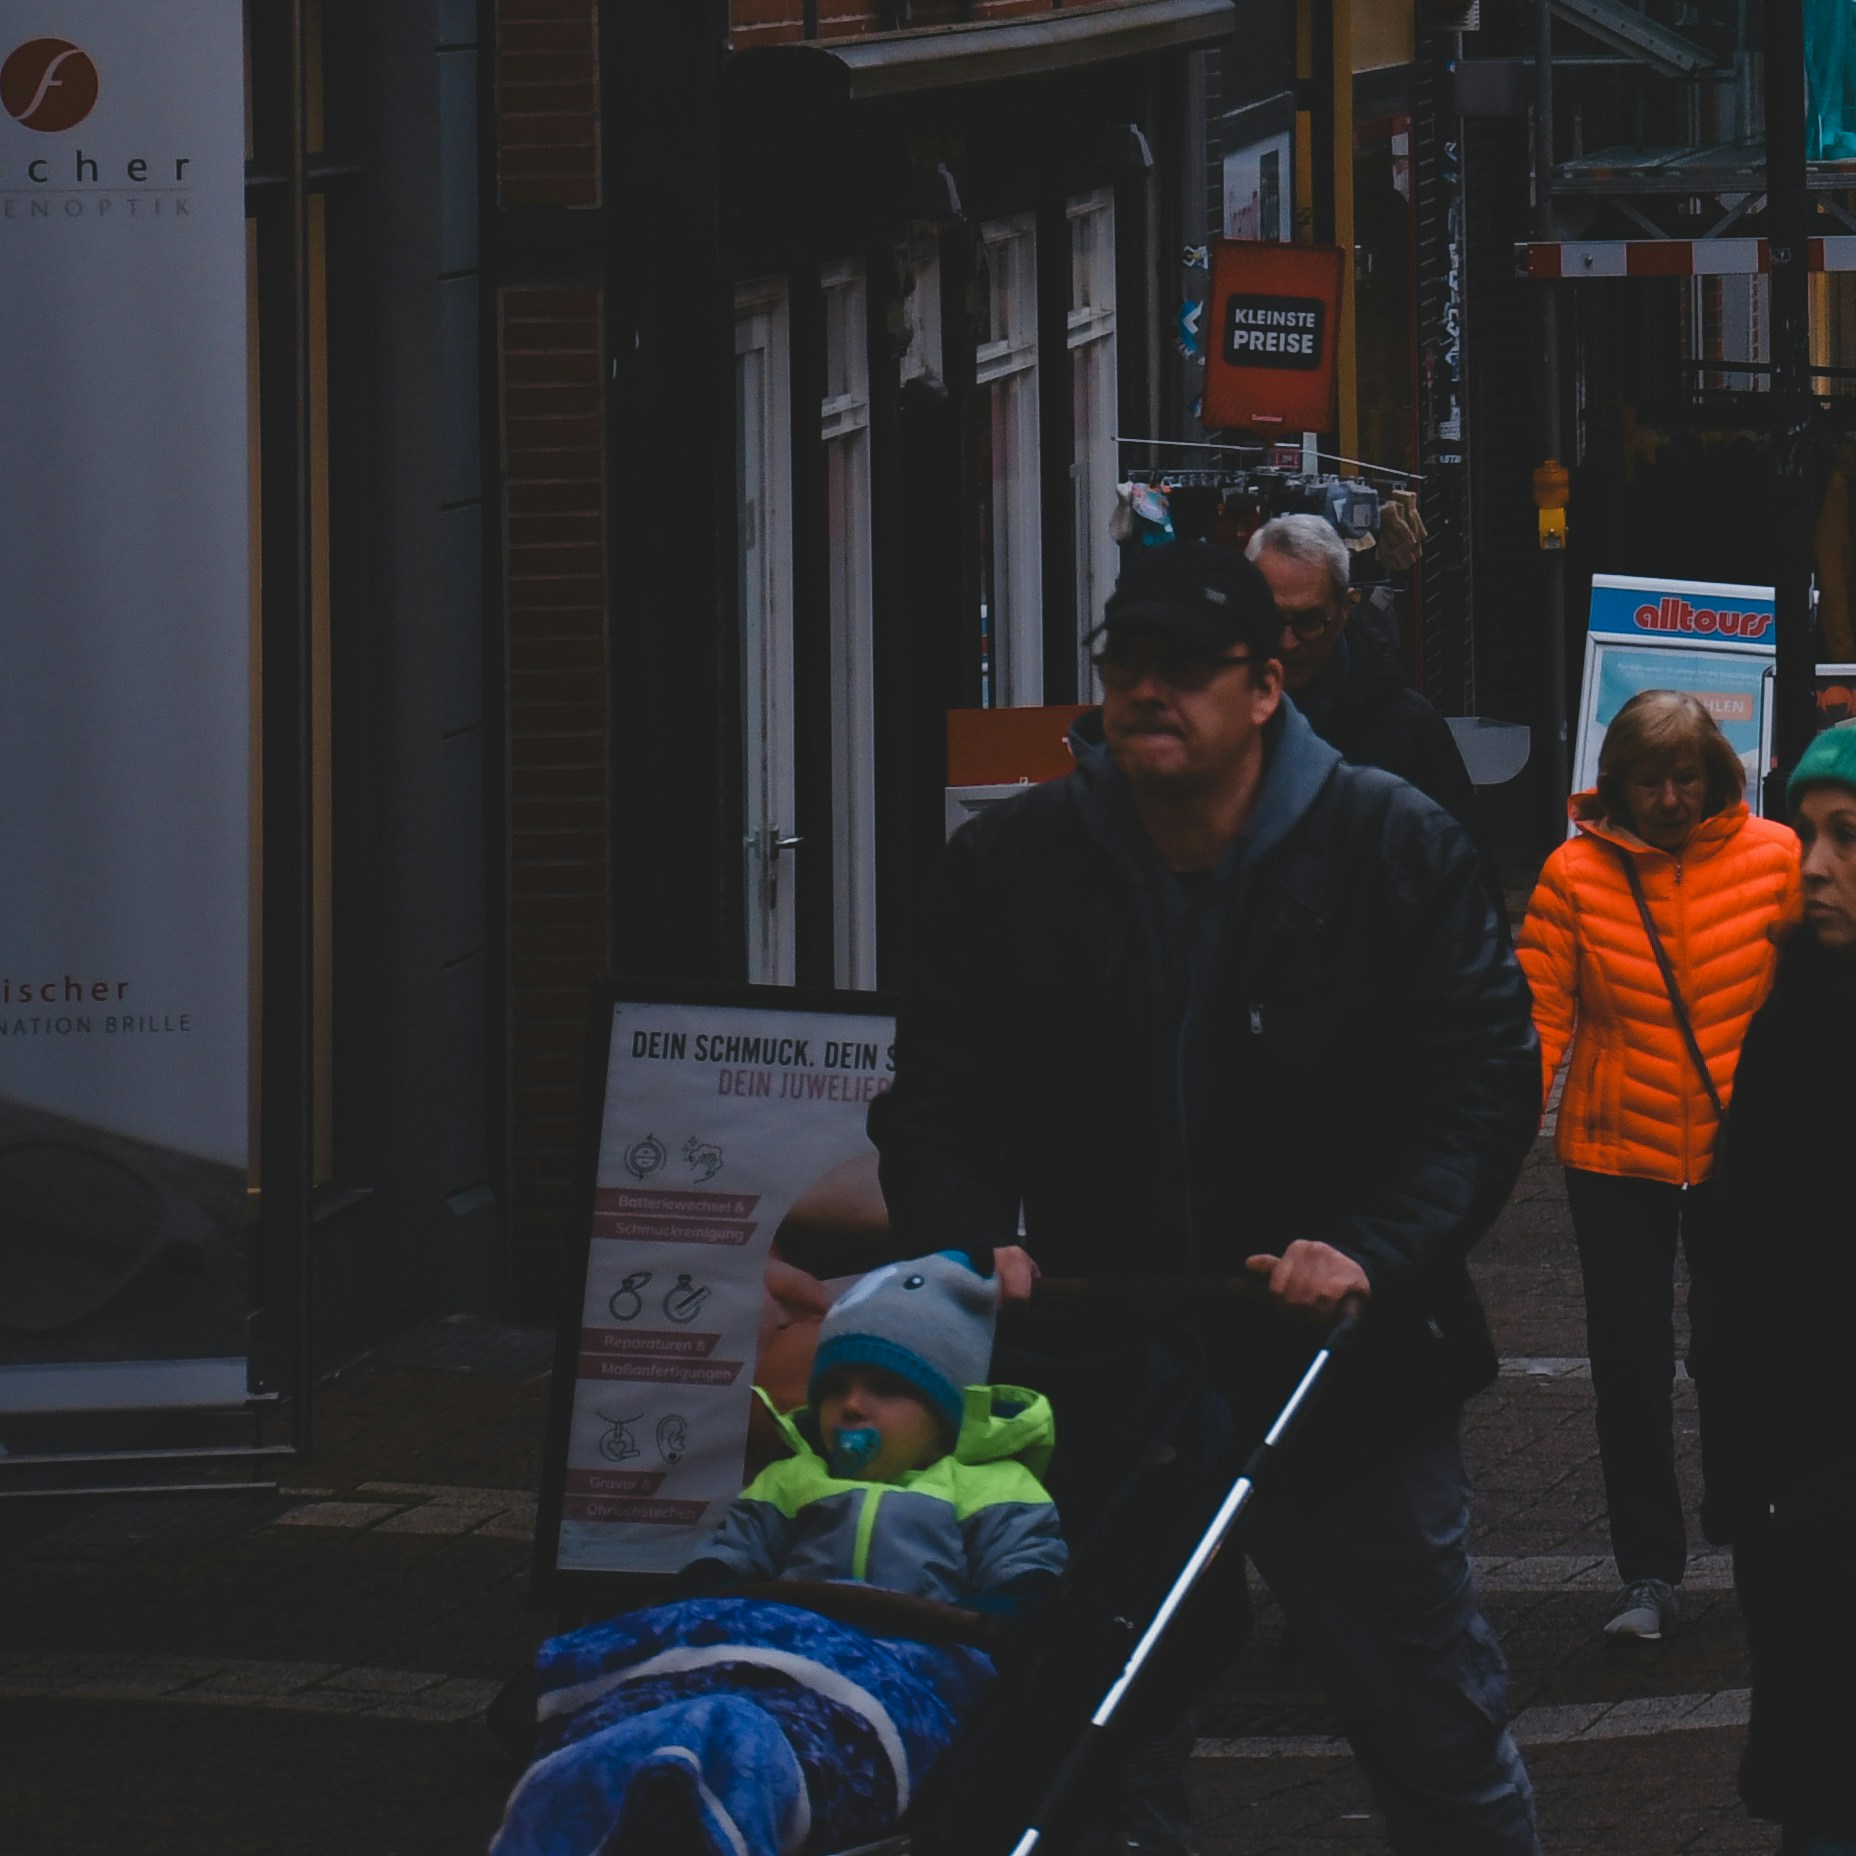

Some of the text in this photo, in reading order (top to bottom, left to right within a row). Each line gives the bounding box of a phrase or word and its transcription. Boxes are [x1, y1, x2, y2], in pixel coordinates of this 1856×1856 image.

[1235, 308, 1316, 328] KLEINSTE
[1232, 330, 1314, 355] PREISE
[1635, 597, 1771, 638] alltours
[104, 1014, 191, 1035] BRILLE
[631, 1031, 687, 1060] DEIN
[693, 1033, 815, 1068] SCHMUCK.
[824, 1041, 878, 1071] DEIN
[717, 1068, 772, 1097] DEIN
[618, 1195, 731, 1214] Batteriewechsel
[615, 1222, 744, 1243] Schmuckreinigung
[603, 1334, 692, 1352] Reparaturen
